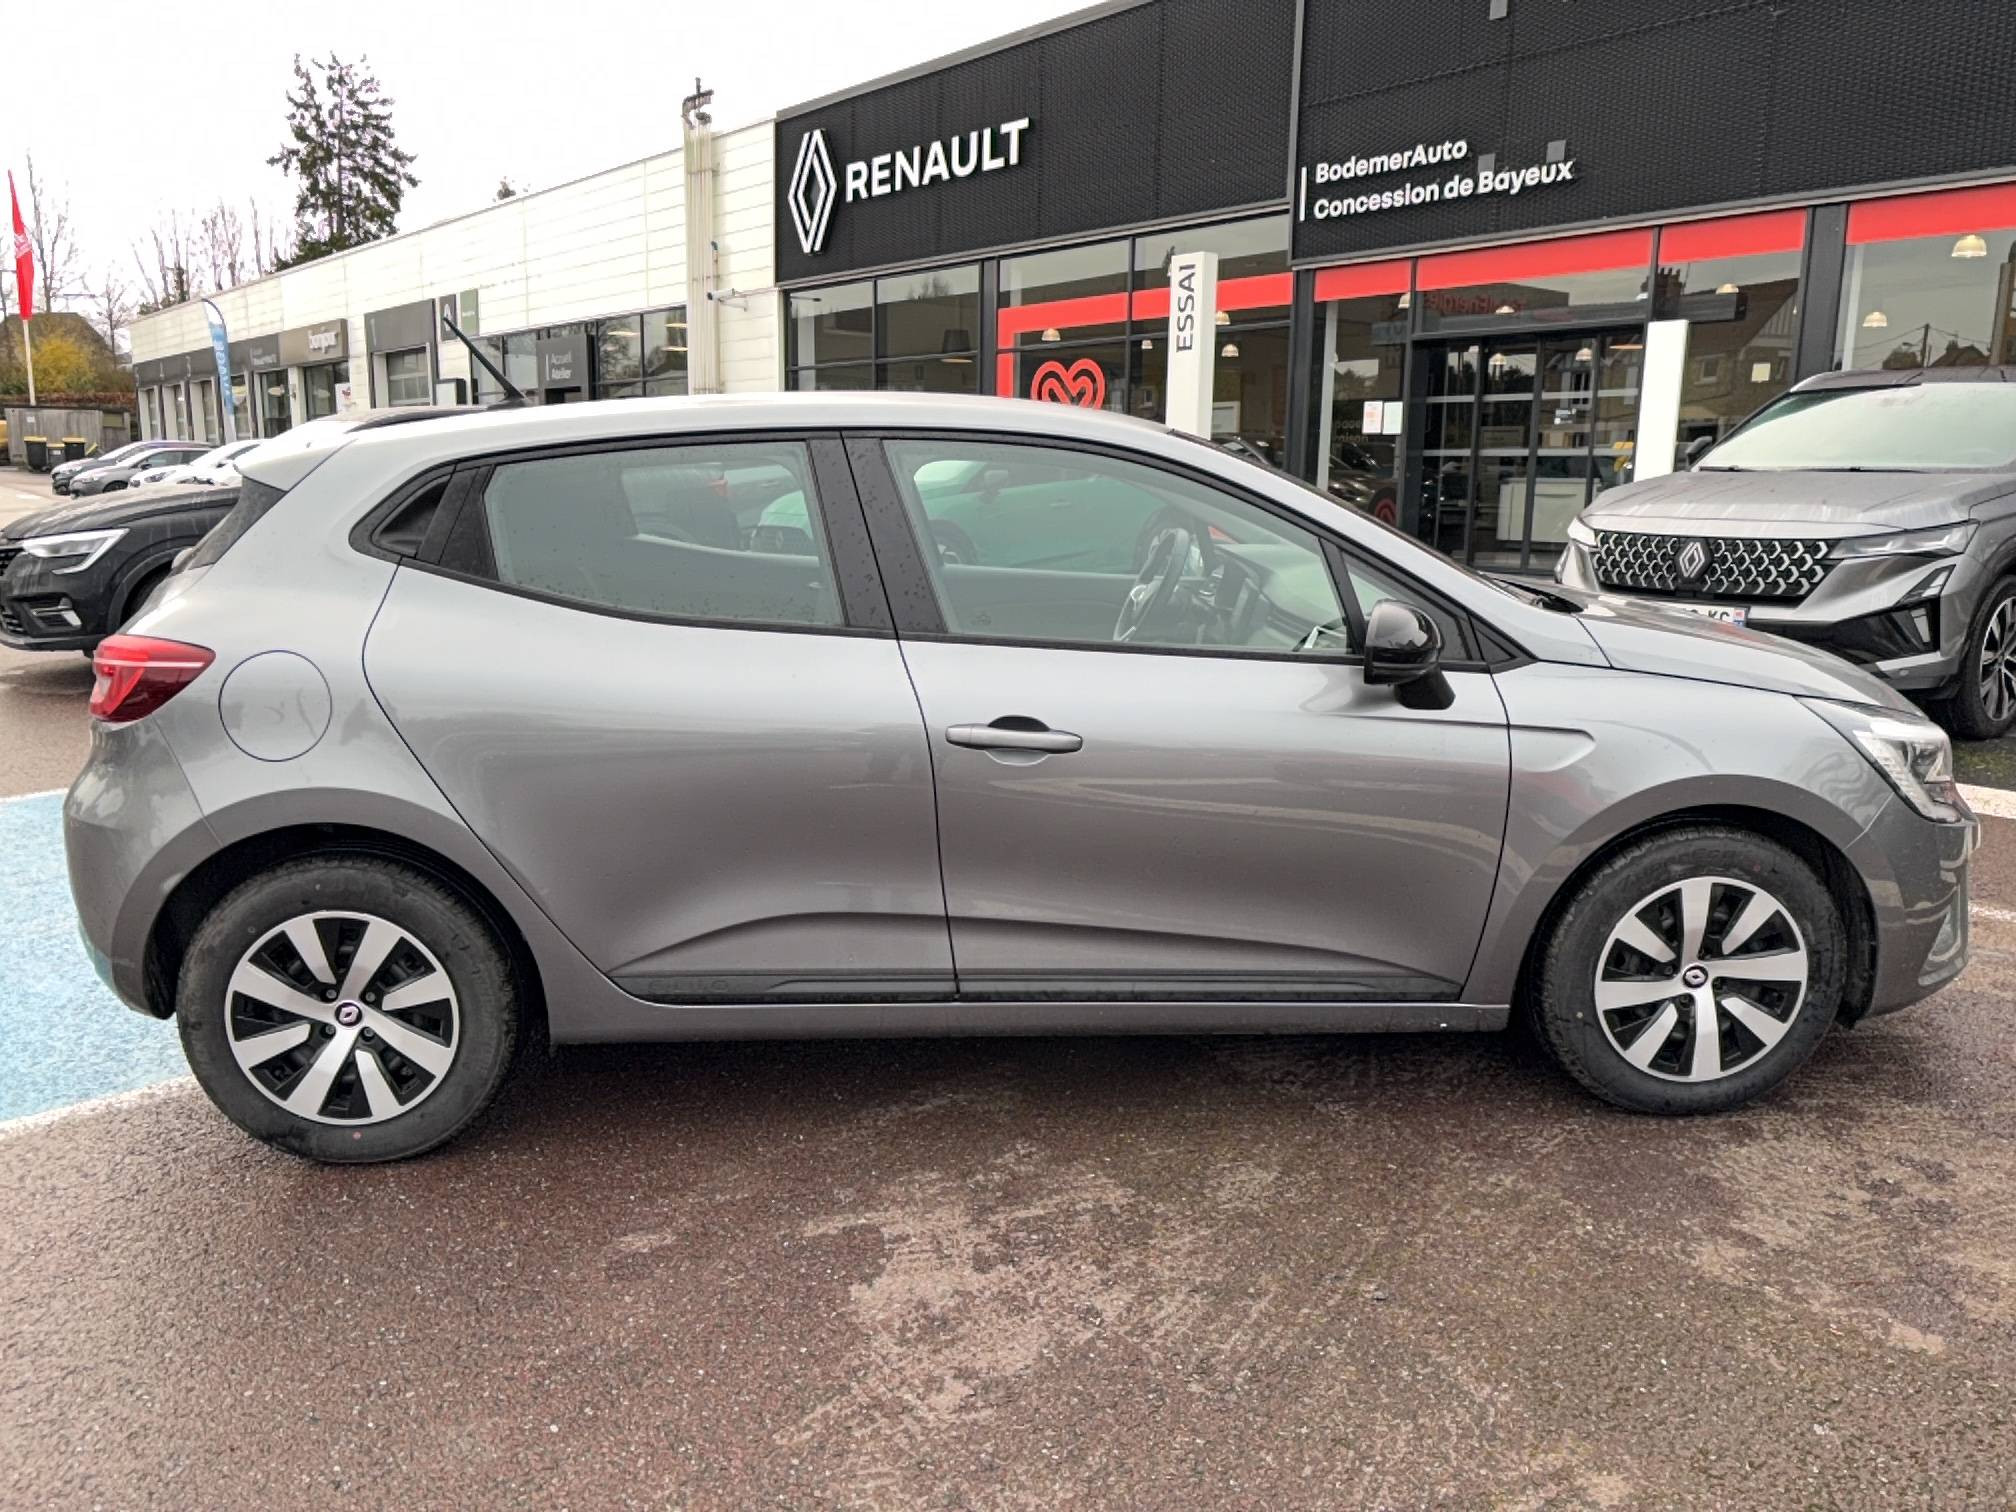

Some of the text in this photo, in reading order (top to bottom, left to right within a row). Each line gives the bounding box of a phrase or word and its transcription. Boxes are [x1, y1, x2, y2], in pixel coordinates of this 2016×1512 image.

[846, 117, 1030, 203] RENAULT
[1313, 160, 1575, 219] Concession de Bayeux
[1315, 139, 1468, 184] BodemerAuto
[1176, 263, 1196, 353] ESSAI
